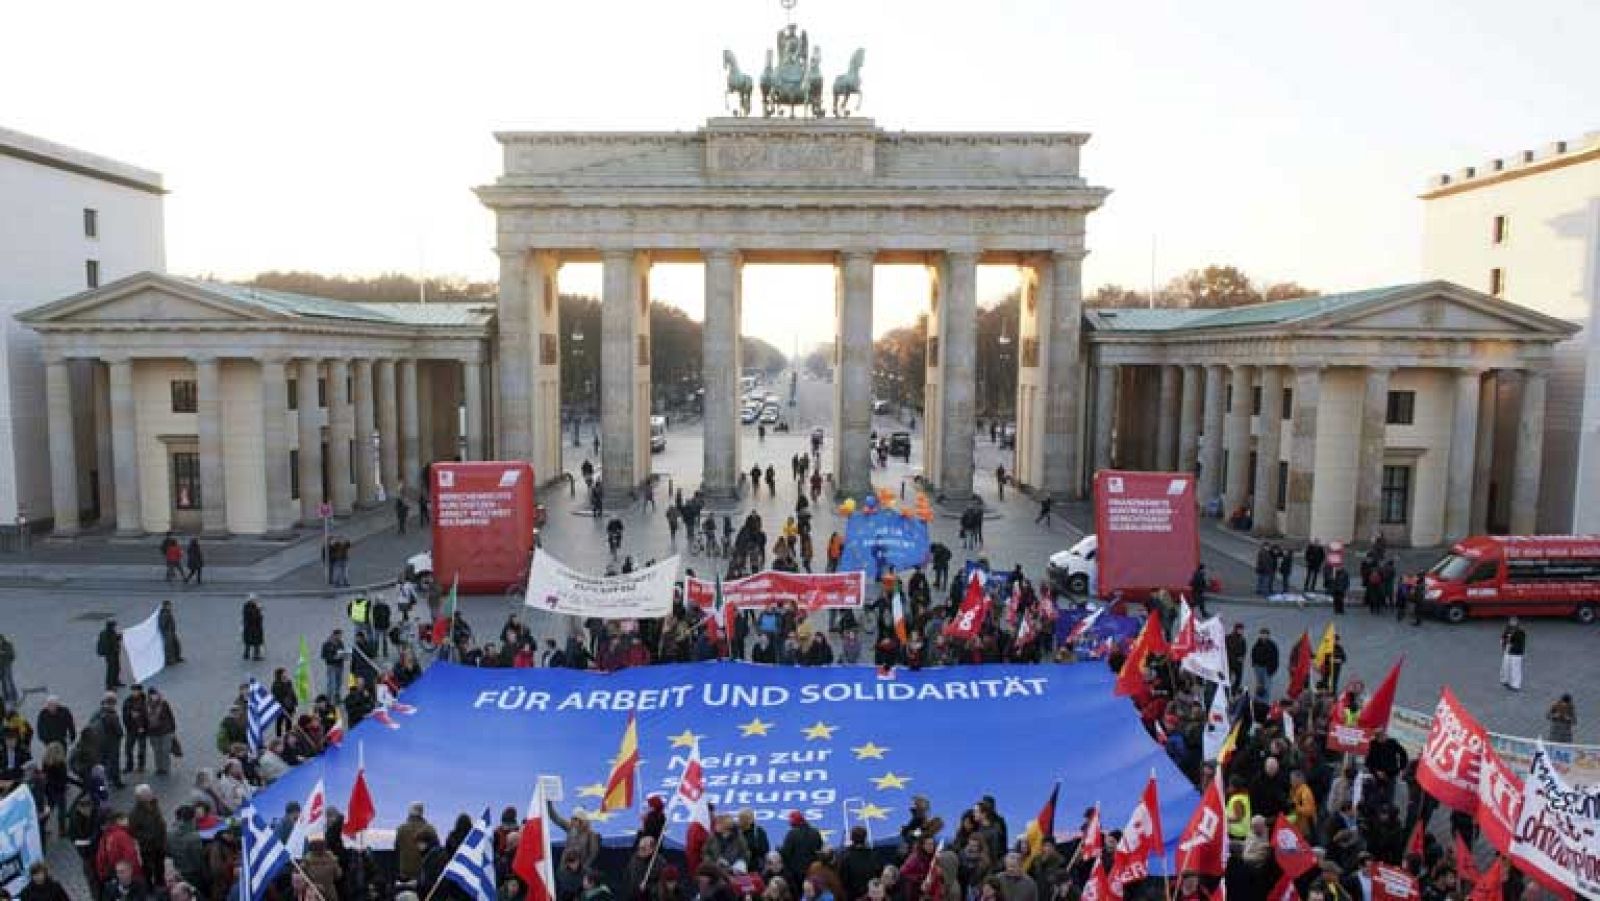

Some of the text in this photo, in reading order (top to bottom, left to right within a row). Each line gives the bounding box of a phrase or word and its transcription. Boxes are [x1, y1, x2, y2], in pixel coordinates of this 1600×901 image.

[473, 676, 1049, 711] FÜR ARBEIT UND SOLIDARITÄT
[769, 748, 832, 765] zur
[661, 767, 829, 787] szialen
